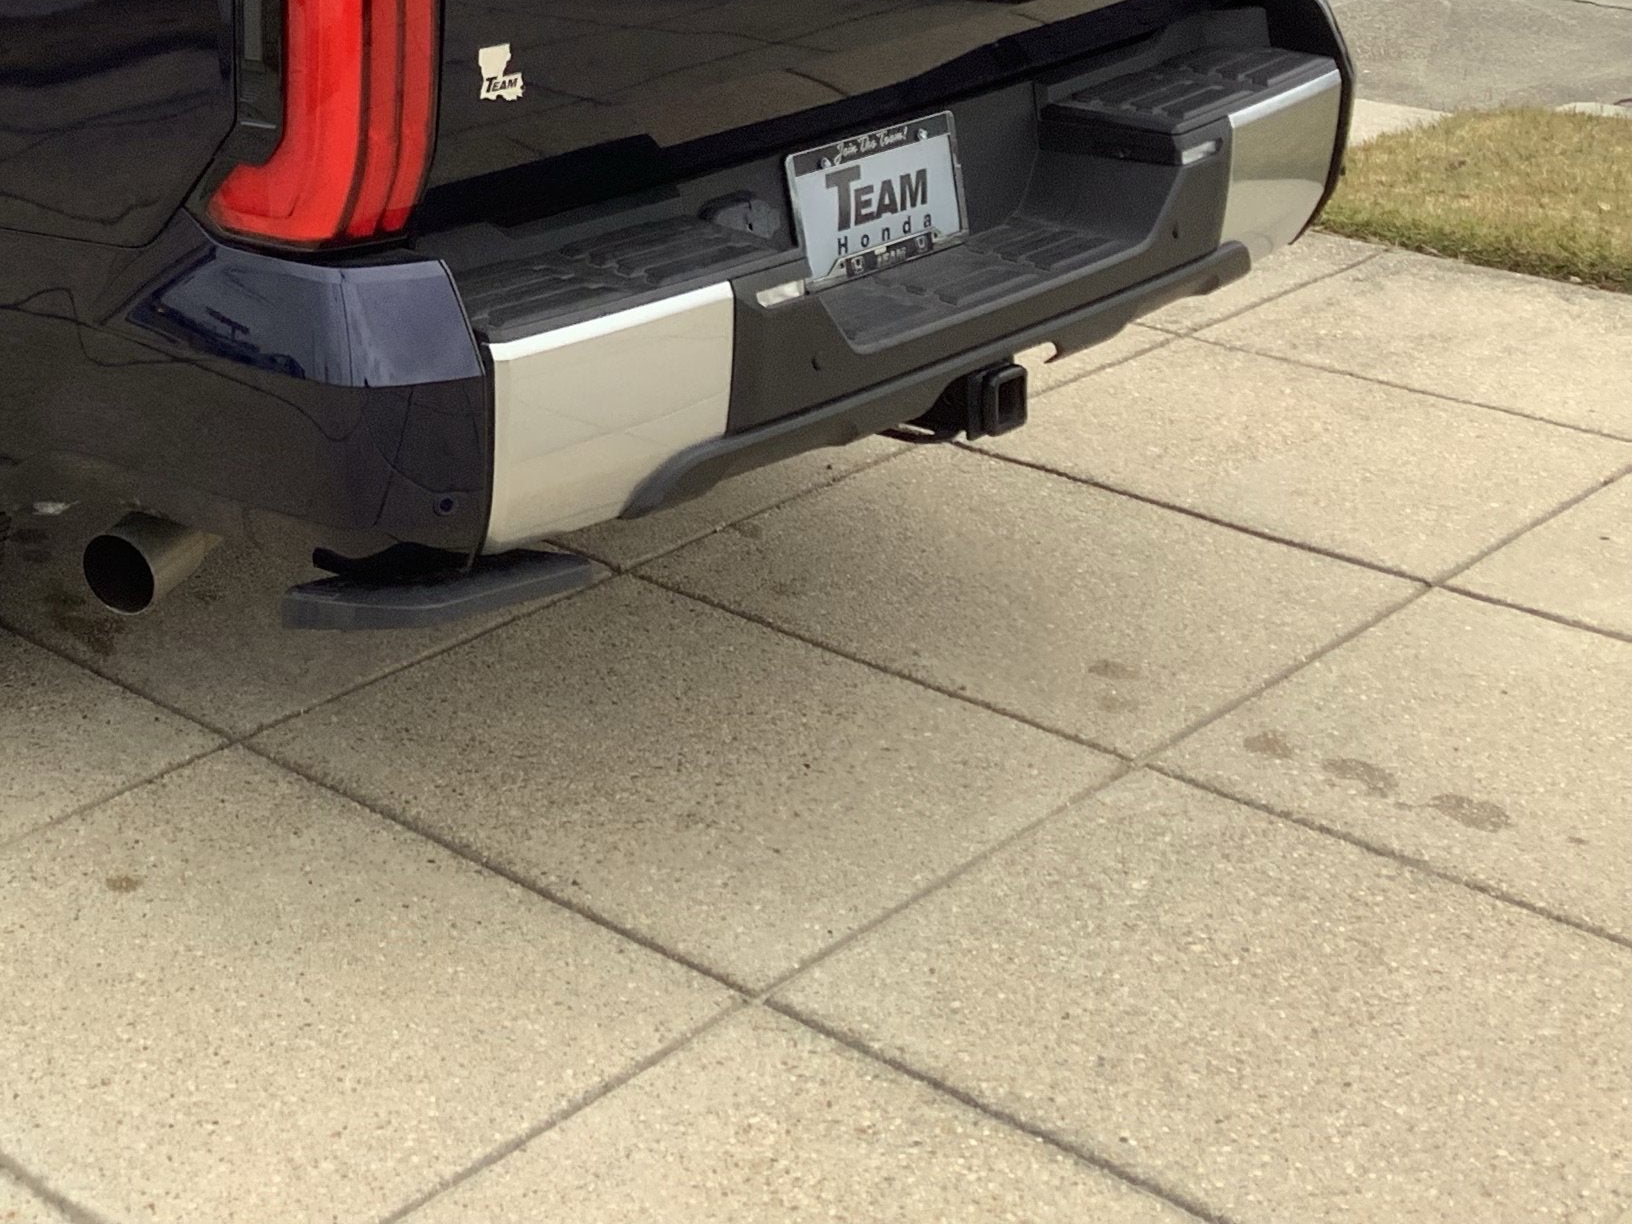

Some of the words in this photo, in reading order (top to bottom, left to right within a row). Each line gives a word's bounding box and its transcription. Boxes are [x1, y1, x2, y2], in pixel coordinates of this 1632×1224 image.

[486, 76, 519, 93] TEAM
[833, 141, 859, 165] Join
[825, 164, 928, 232] TEAM
[837, 213, 933, 256] Honda
